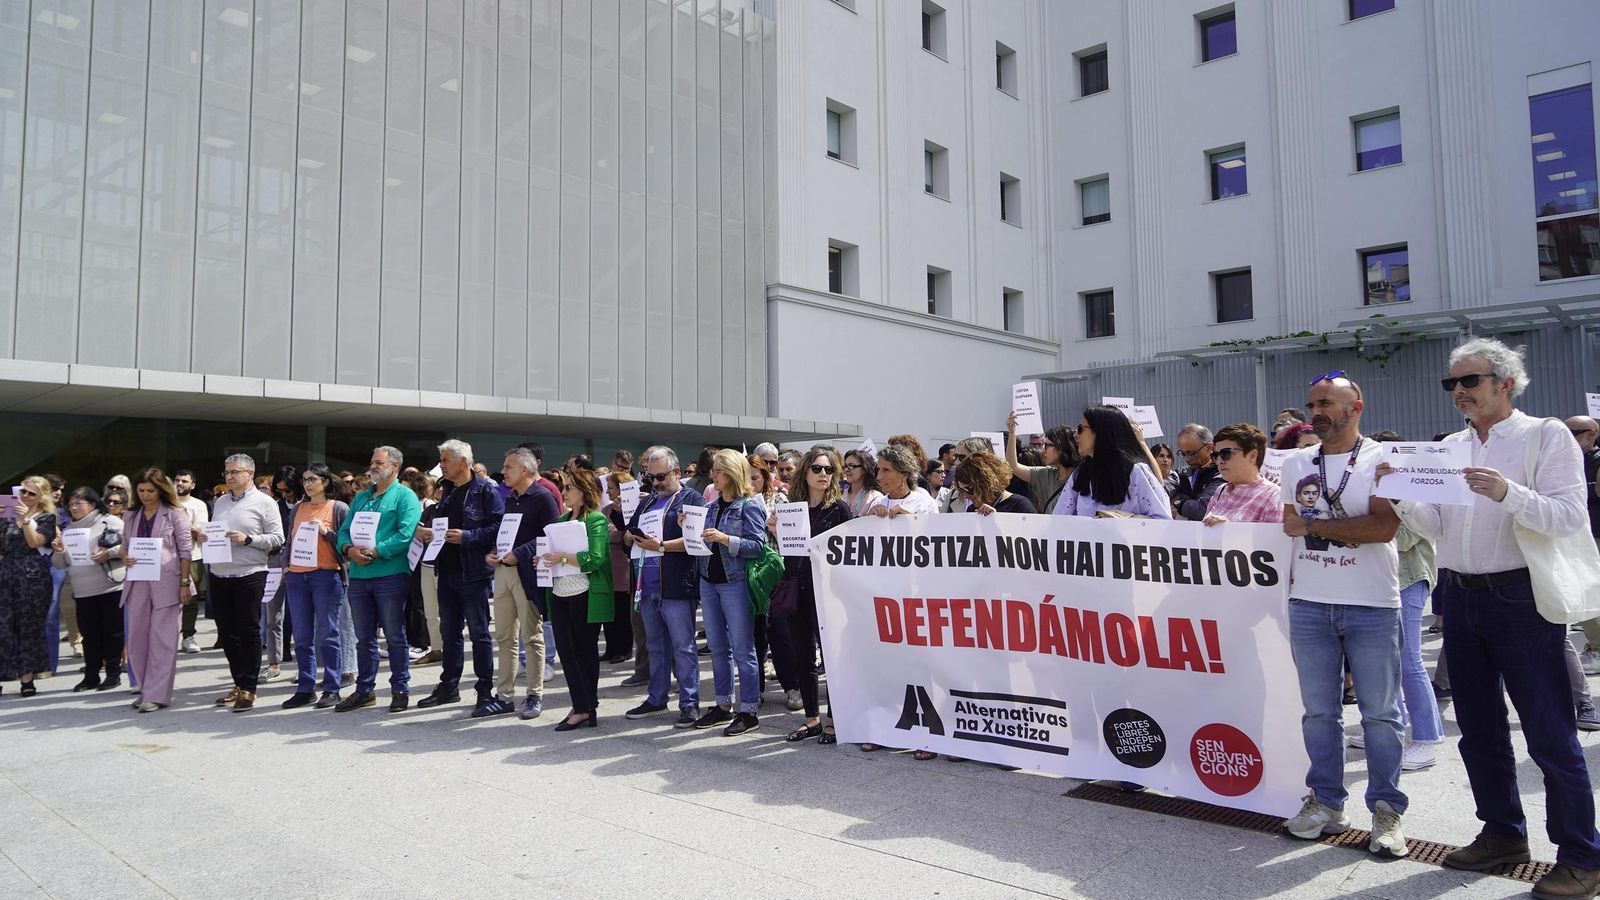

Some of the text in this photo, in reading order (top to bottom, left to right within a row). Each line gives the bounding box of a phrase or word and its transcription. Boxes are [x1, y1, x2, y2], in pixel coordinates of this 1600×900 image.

[1417, 467, 1462, 476] MOBILIDADE
[826, 535, 1279, 587] SEN XUSTIZA NON HAI DEREITOS
[1323, 556, 1336, 568] you
[1340, 555, 1357, 566] love
[873, 594, 1226, 674] DEFENDÁMOLA!
[954, 700, 1068, 728] Alternativas
[956, 717, 1050, 743] na Xustiza
[1113, 719, 1150, 731] FORTES
[1116, 728, 1150, 739] LIBRES
[1118, 734, 1162, 747] INDEPEN
[1116, 743, 1154, 755] DENTES
[1195, 738, 1225, 752] SEN
[1198, 750, 1261, 767] SUBVEN-
[1200, 763, 1249, 778] CIONS
